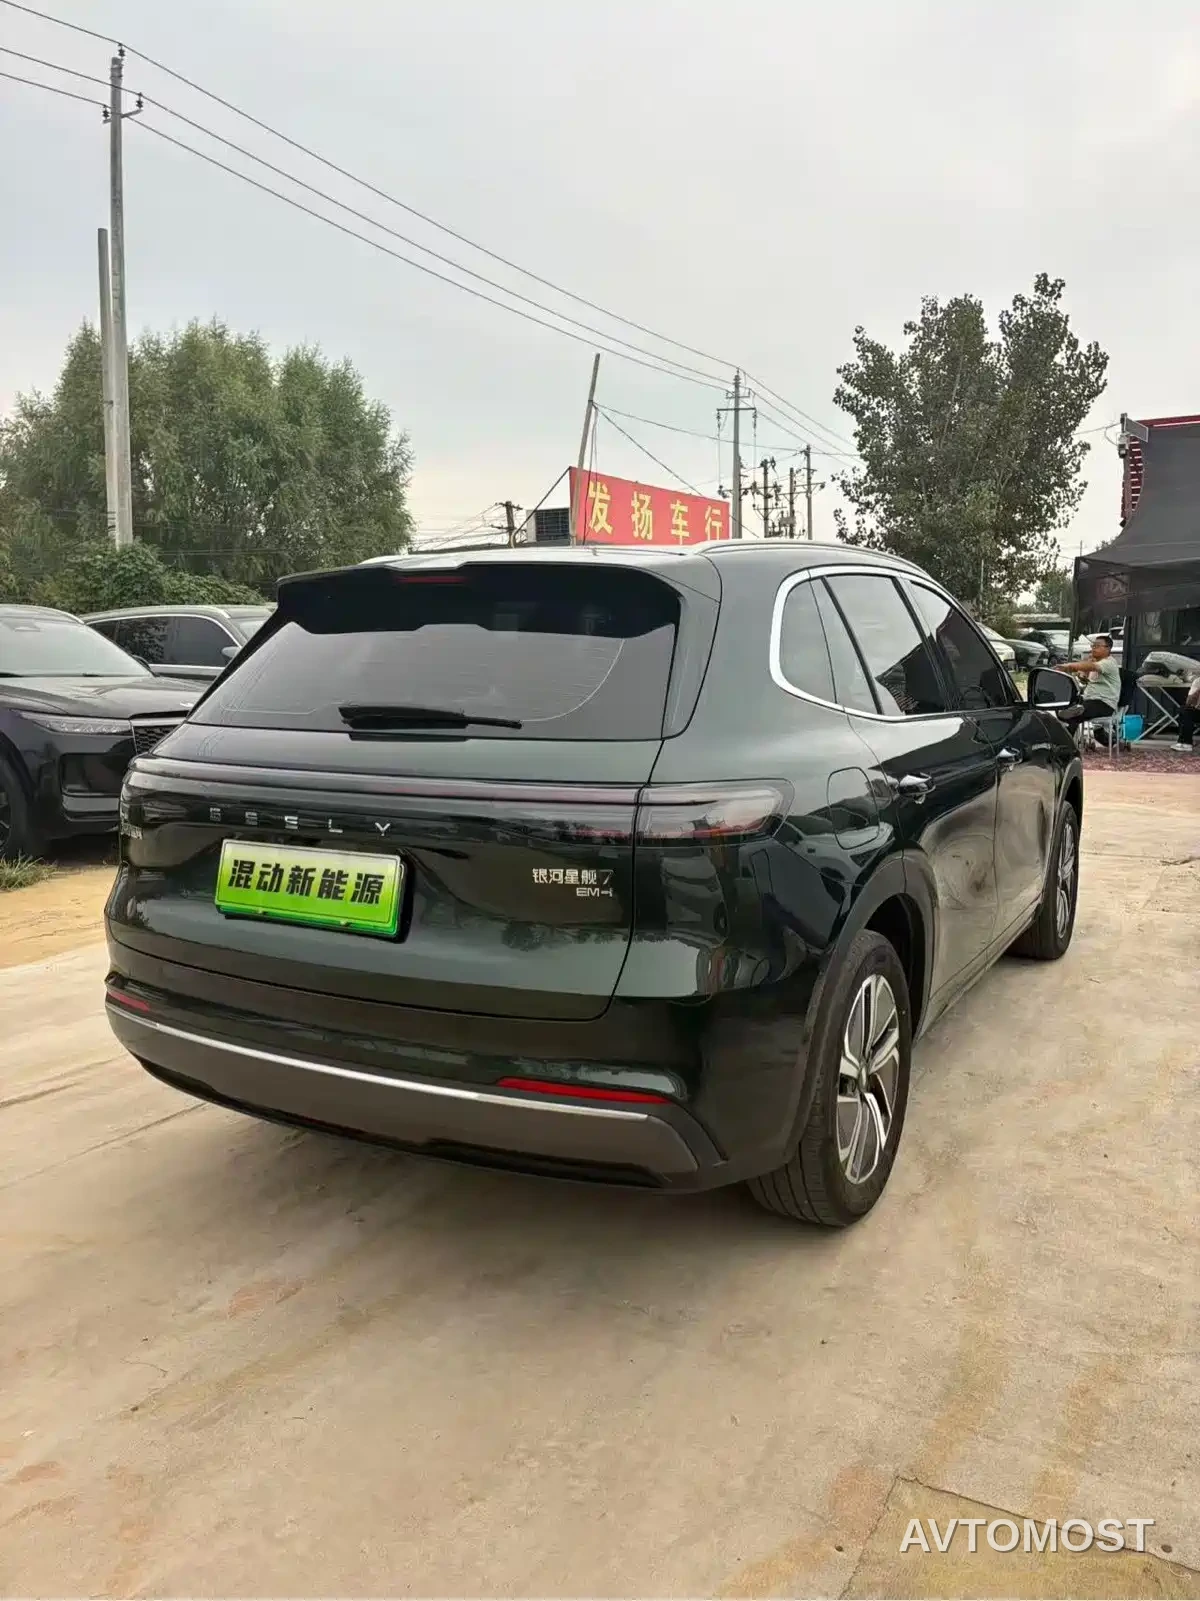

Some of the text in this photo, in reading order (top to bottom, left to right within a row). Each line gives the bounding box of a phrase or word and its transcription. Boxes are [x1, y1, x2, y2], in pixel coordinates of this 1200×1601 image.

[588, 481, 723, 545] 发扬车行
[209, 806, 391, 837] GEELY
[228, 859, 386, 905] 混动新能源
